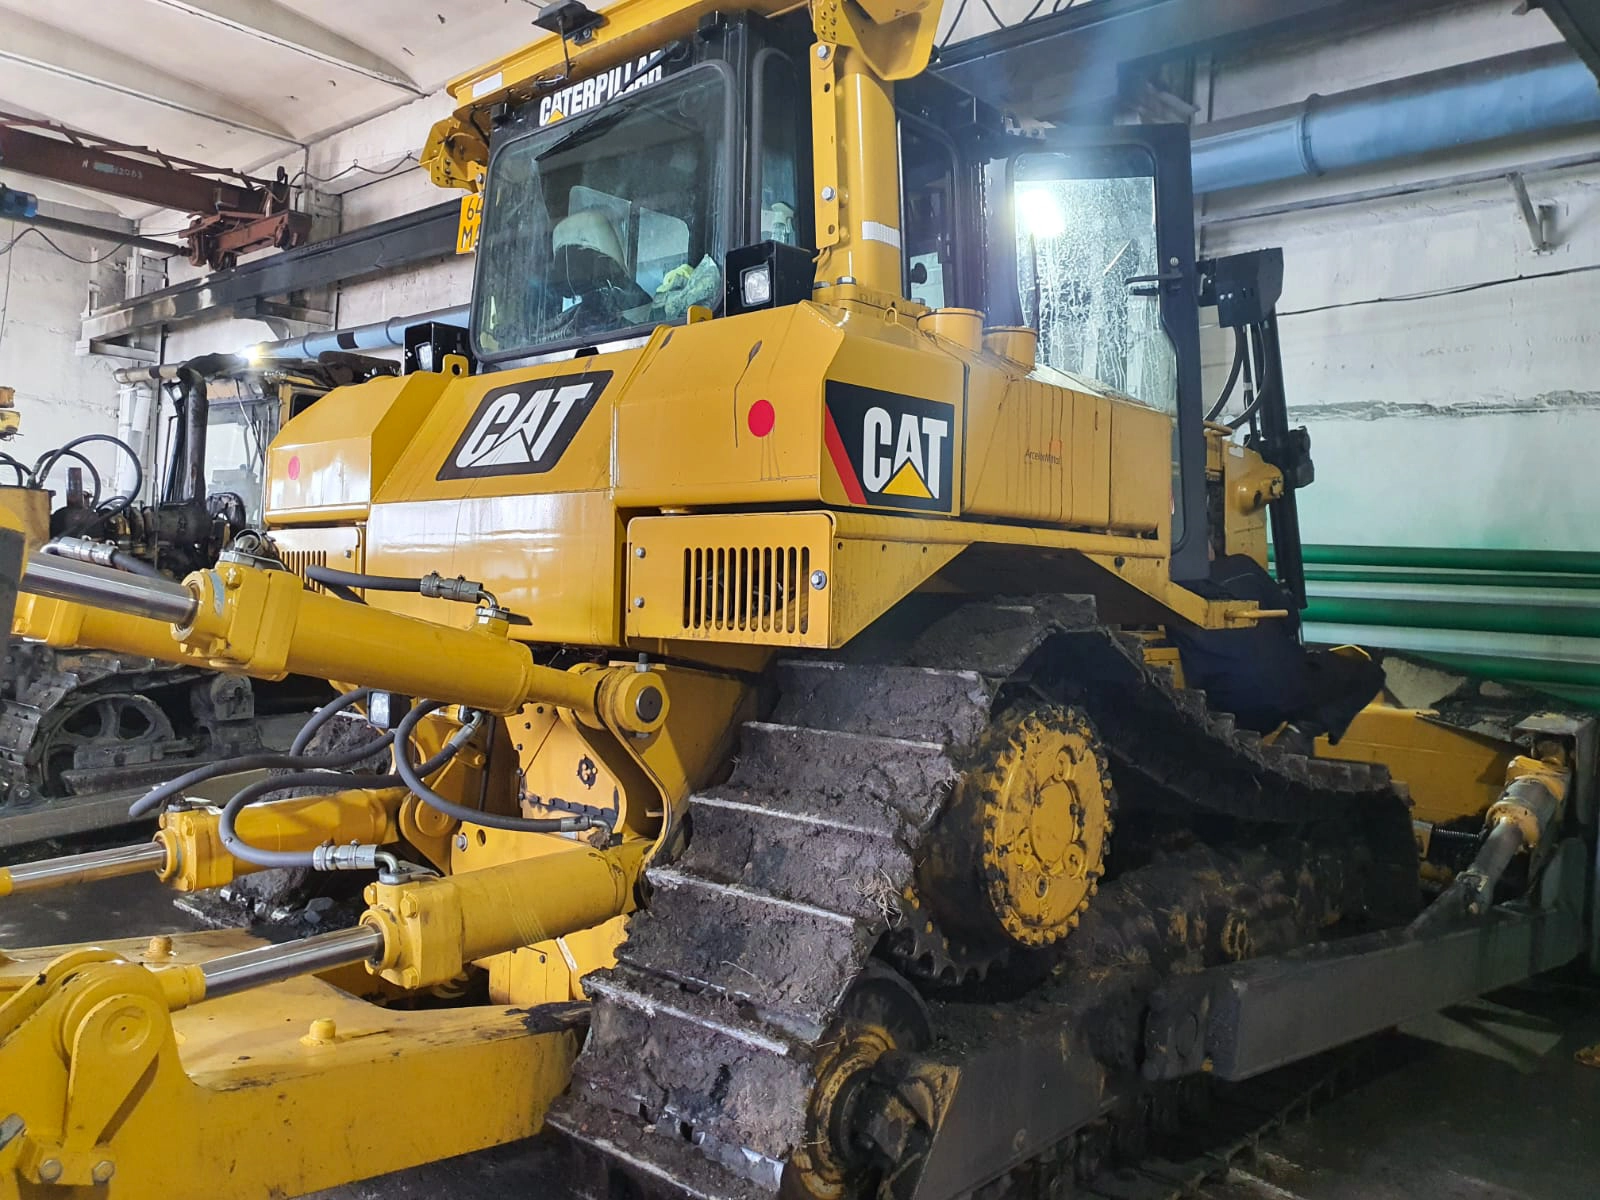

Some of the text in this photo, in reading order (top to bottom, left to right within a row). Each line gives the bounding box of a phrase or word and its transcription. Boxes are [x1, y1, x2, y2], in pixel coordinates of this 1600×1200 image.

[539, 49, 662, 127] CATERPILLAR
[455, 382, 594, 468] CAT
[863, 406, 948, 500] CAT
